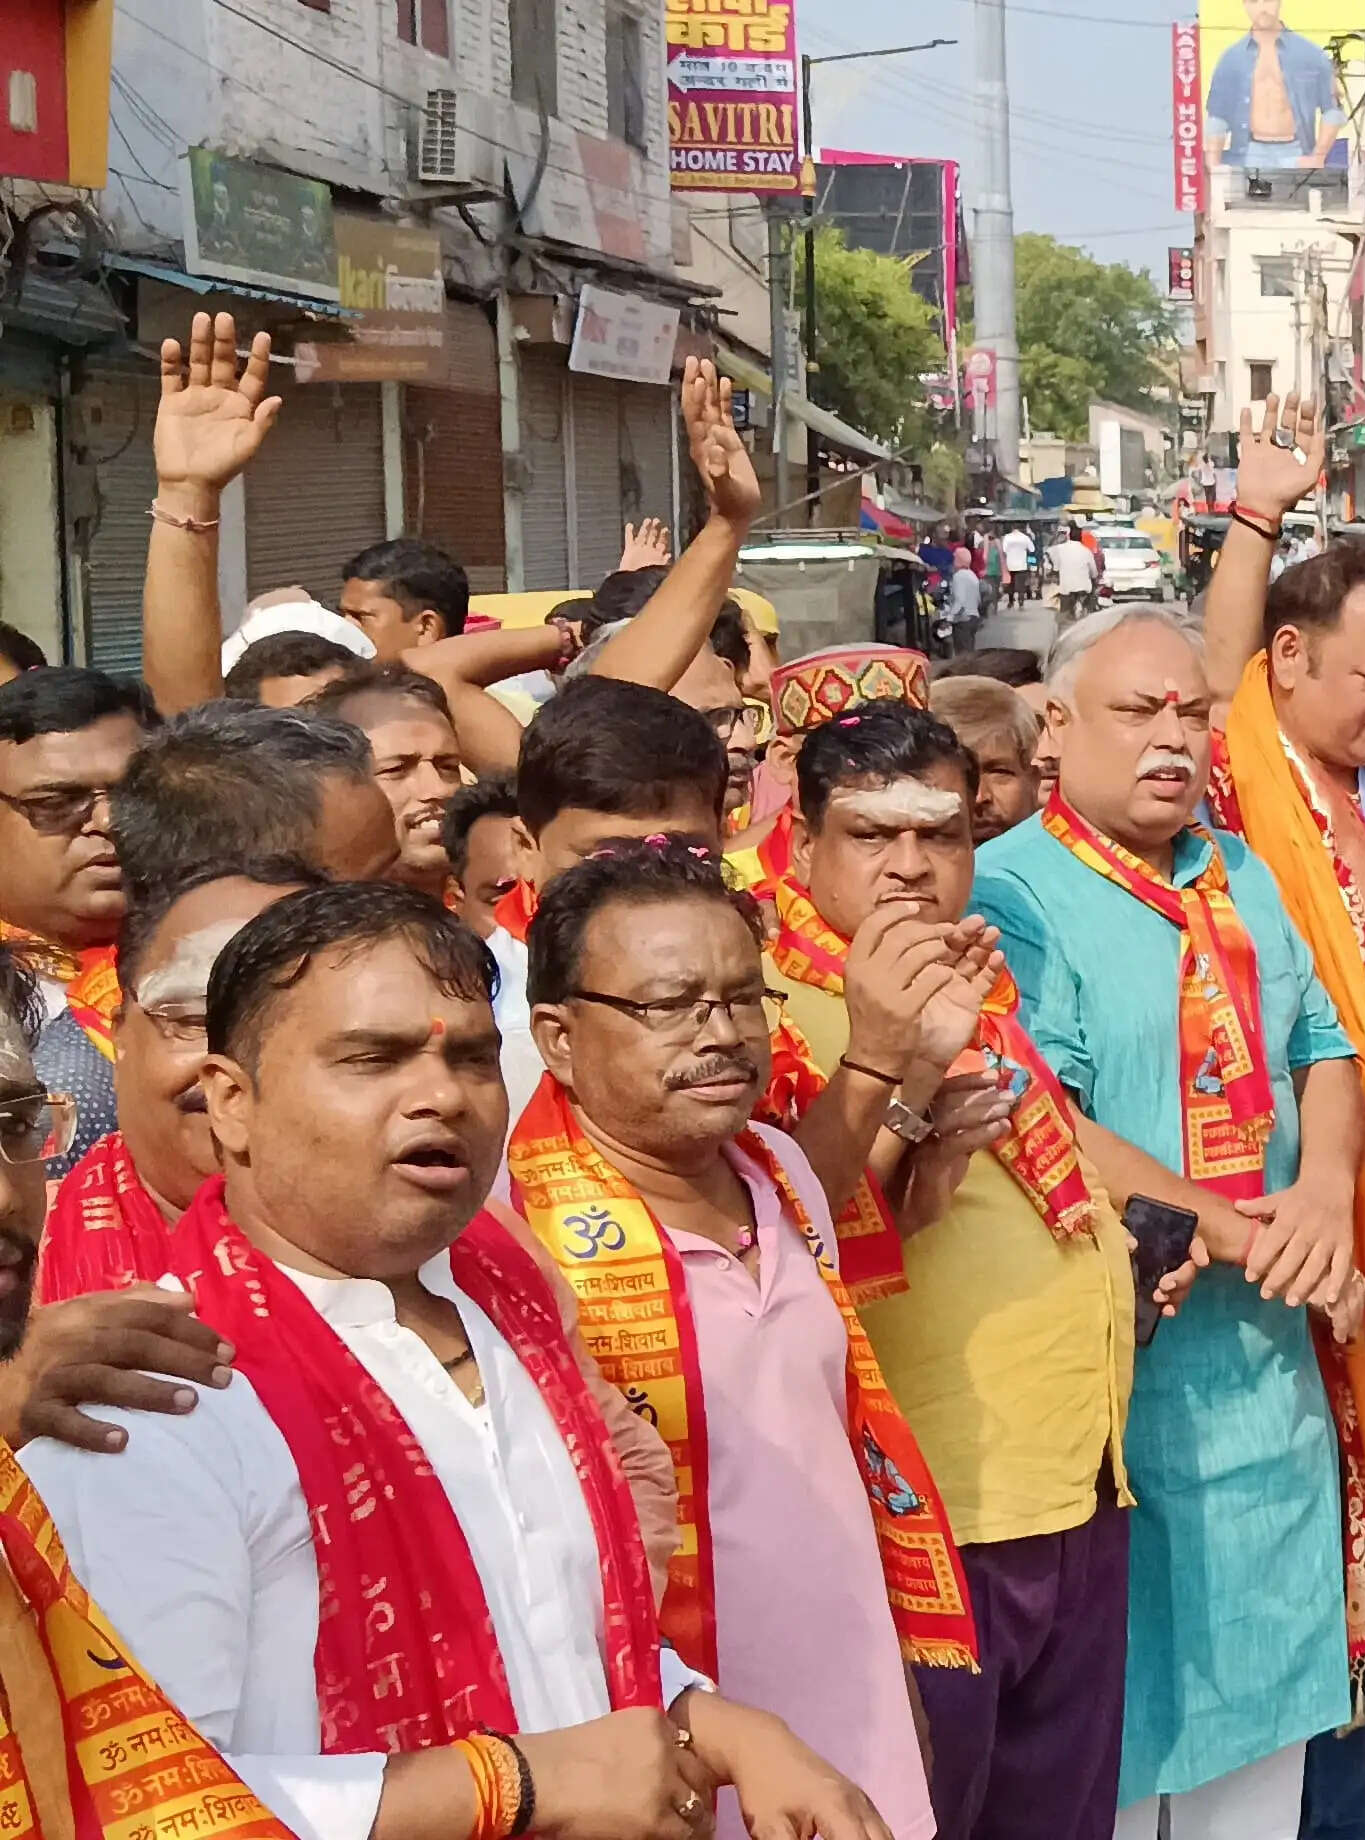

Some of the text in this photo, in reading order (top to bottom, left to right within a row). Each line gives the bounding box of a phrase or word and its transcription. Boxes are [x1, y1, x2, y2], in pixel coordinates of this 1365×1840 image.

[665, 4, 790, 51] कार्ड
[669, 101, 794, 145] SAVITRI
[671, 150, 794, 173] HOME STAY
[1178, 103, 1198, 211] HOTELS
[562, 1205, 626, 1259] ॐ
